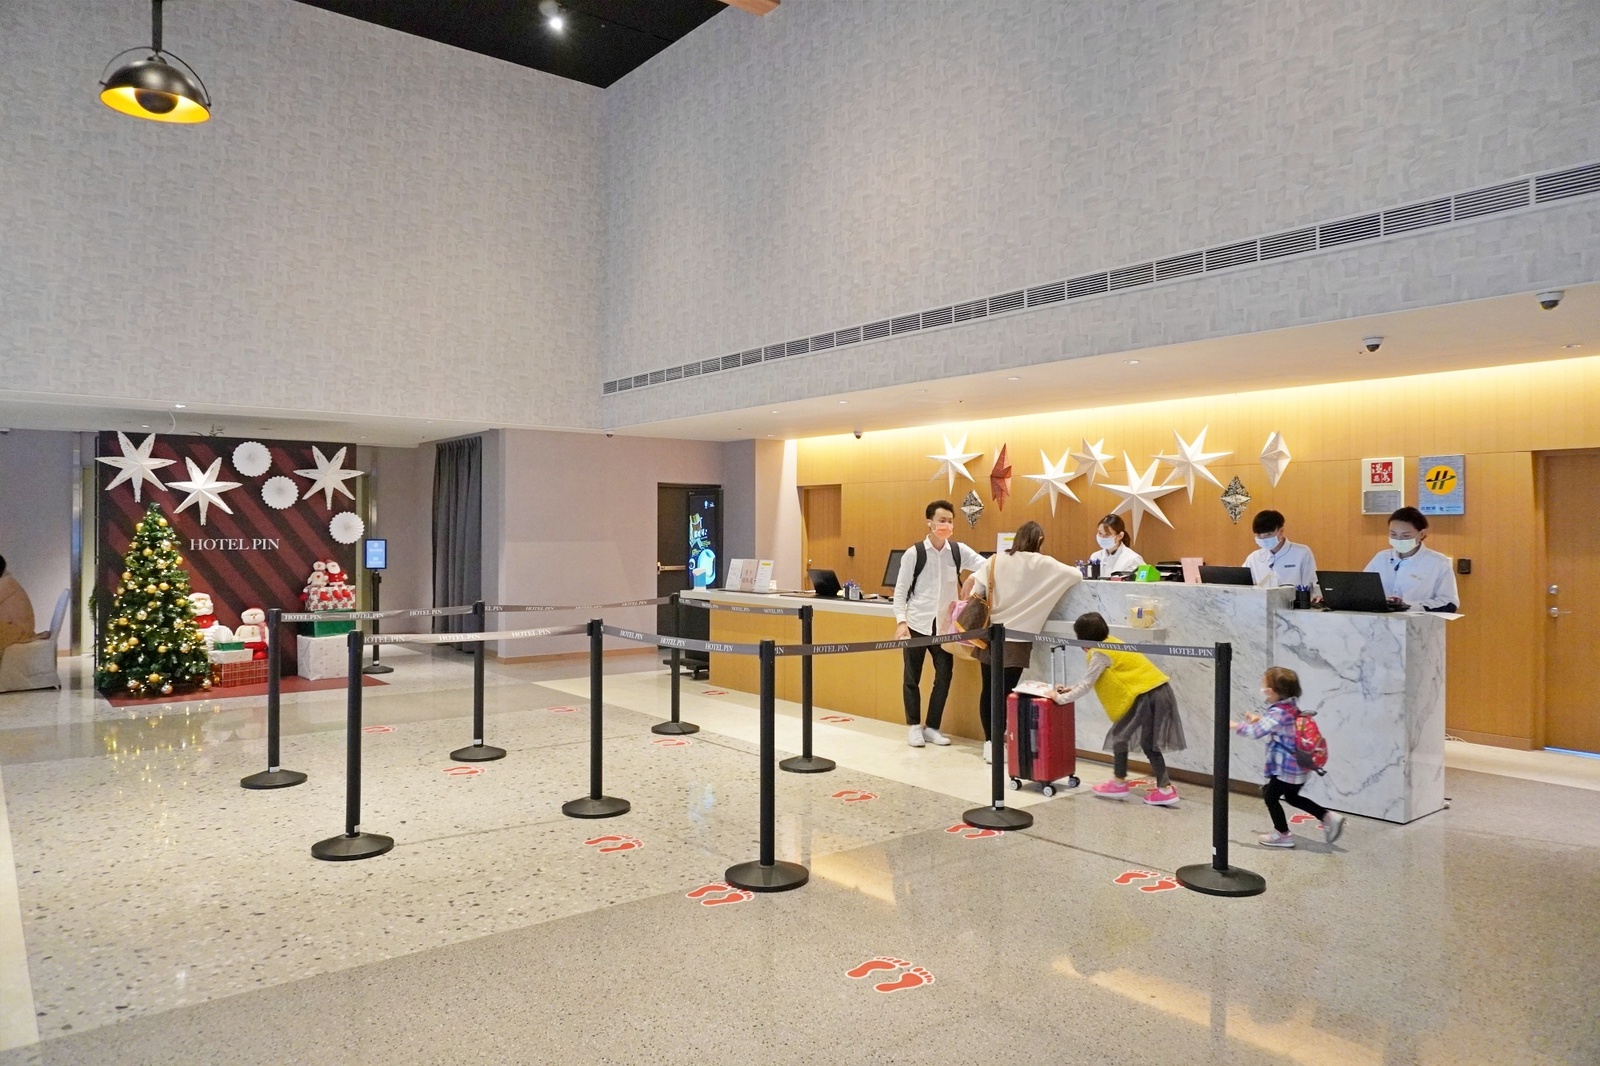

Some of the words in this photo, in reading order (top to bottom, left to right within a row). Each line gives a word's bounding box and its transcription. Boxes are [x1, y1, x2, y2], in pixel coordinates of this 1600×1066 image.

[190, 538, 249, 551] HOTEL
[252, 538, 280, 550] PIN
[511, 630, 538, 638] HOTEL
[619, 630, 635, 639] HOTEL
[660, 637, 677, 646] HOTEL
[677, 639, 686, 647] PIN
[1034, 635, 1058, 644] HOTEL
[705, 643, 723, 651] HOTEL
[1097, 643, 1124, 651] HOTEL
[1169, 647, 1197, 655] HOTEL
[1198, 648, 1213, 656] PIN
